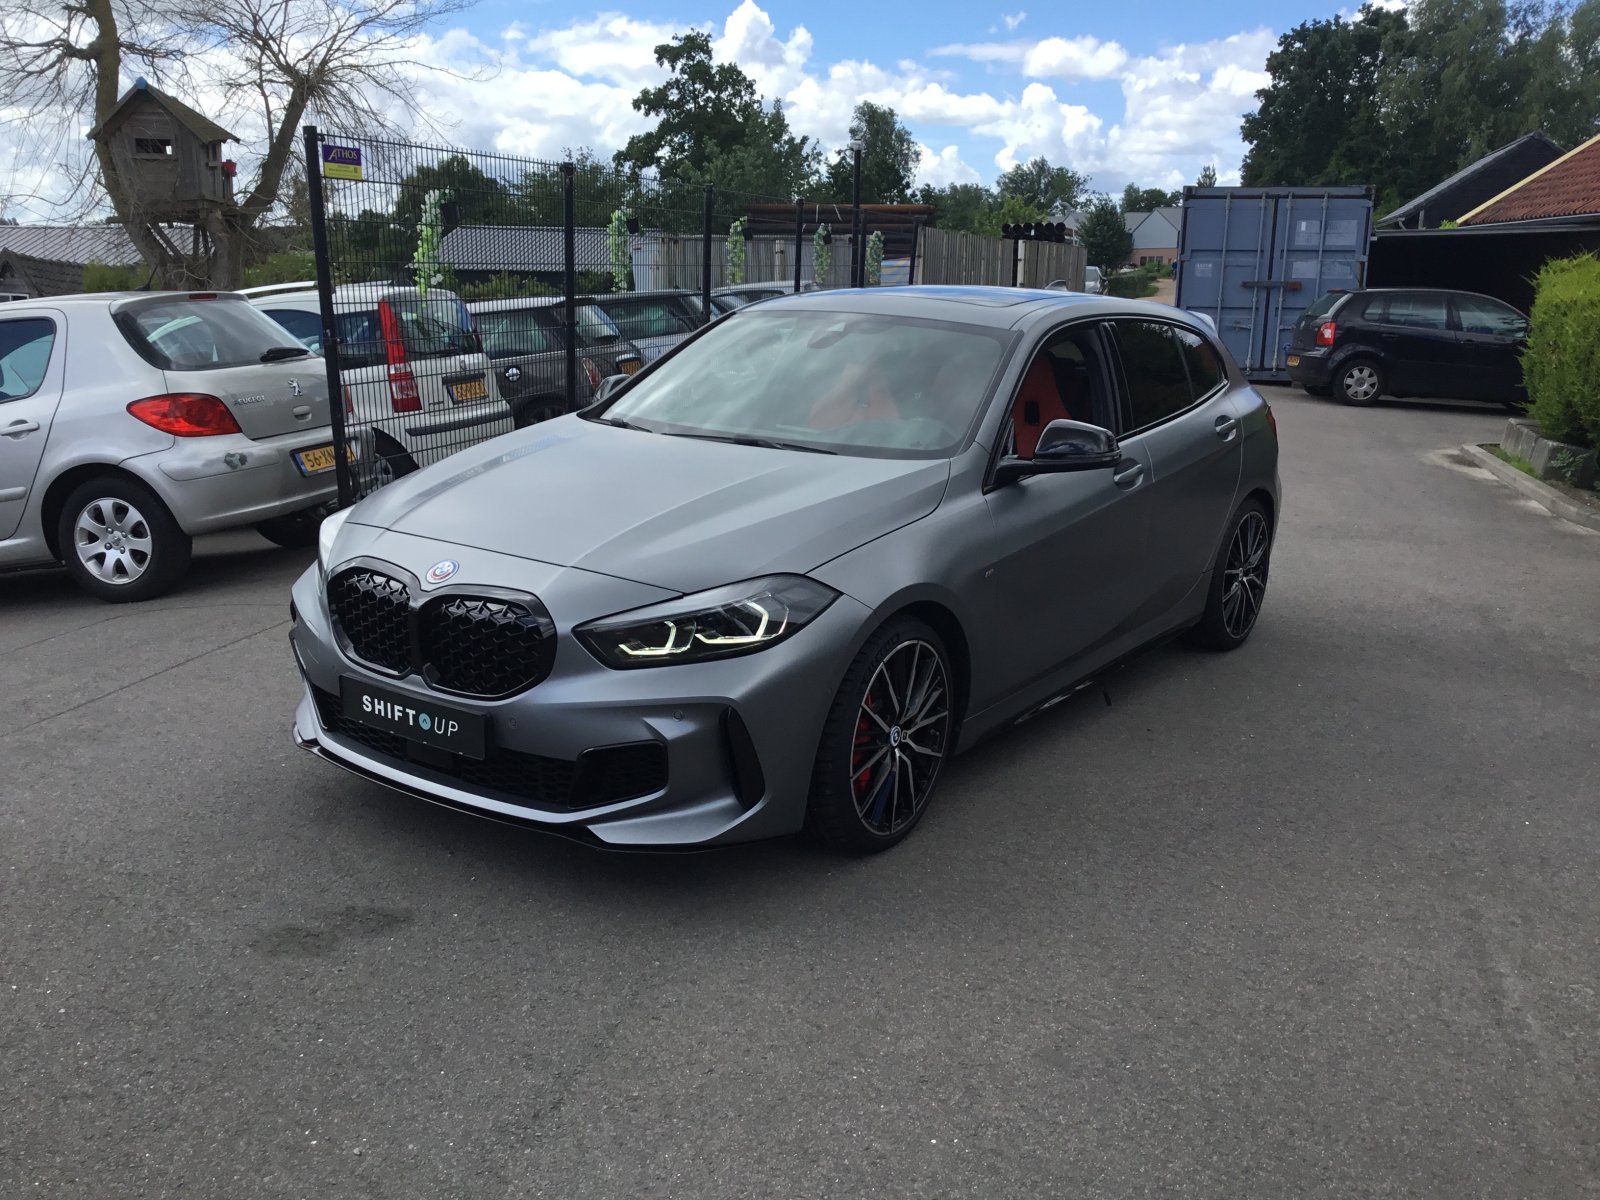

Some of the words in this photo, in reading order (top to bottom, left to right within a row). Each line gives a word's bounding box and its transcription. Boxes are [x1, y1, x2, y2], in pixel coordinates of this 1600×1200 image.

[328, 148, 357, 160] ATHOS
[362, 694, 416, 726] SHIFT
[434, 717, 458, 737] UP
